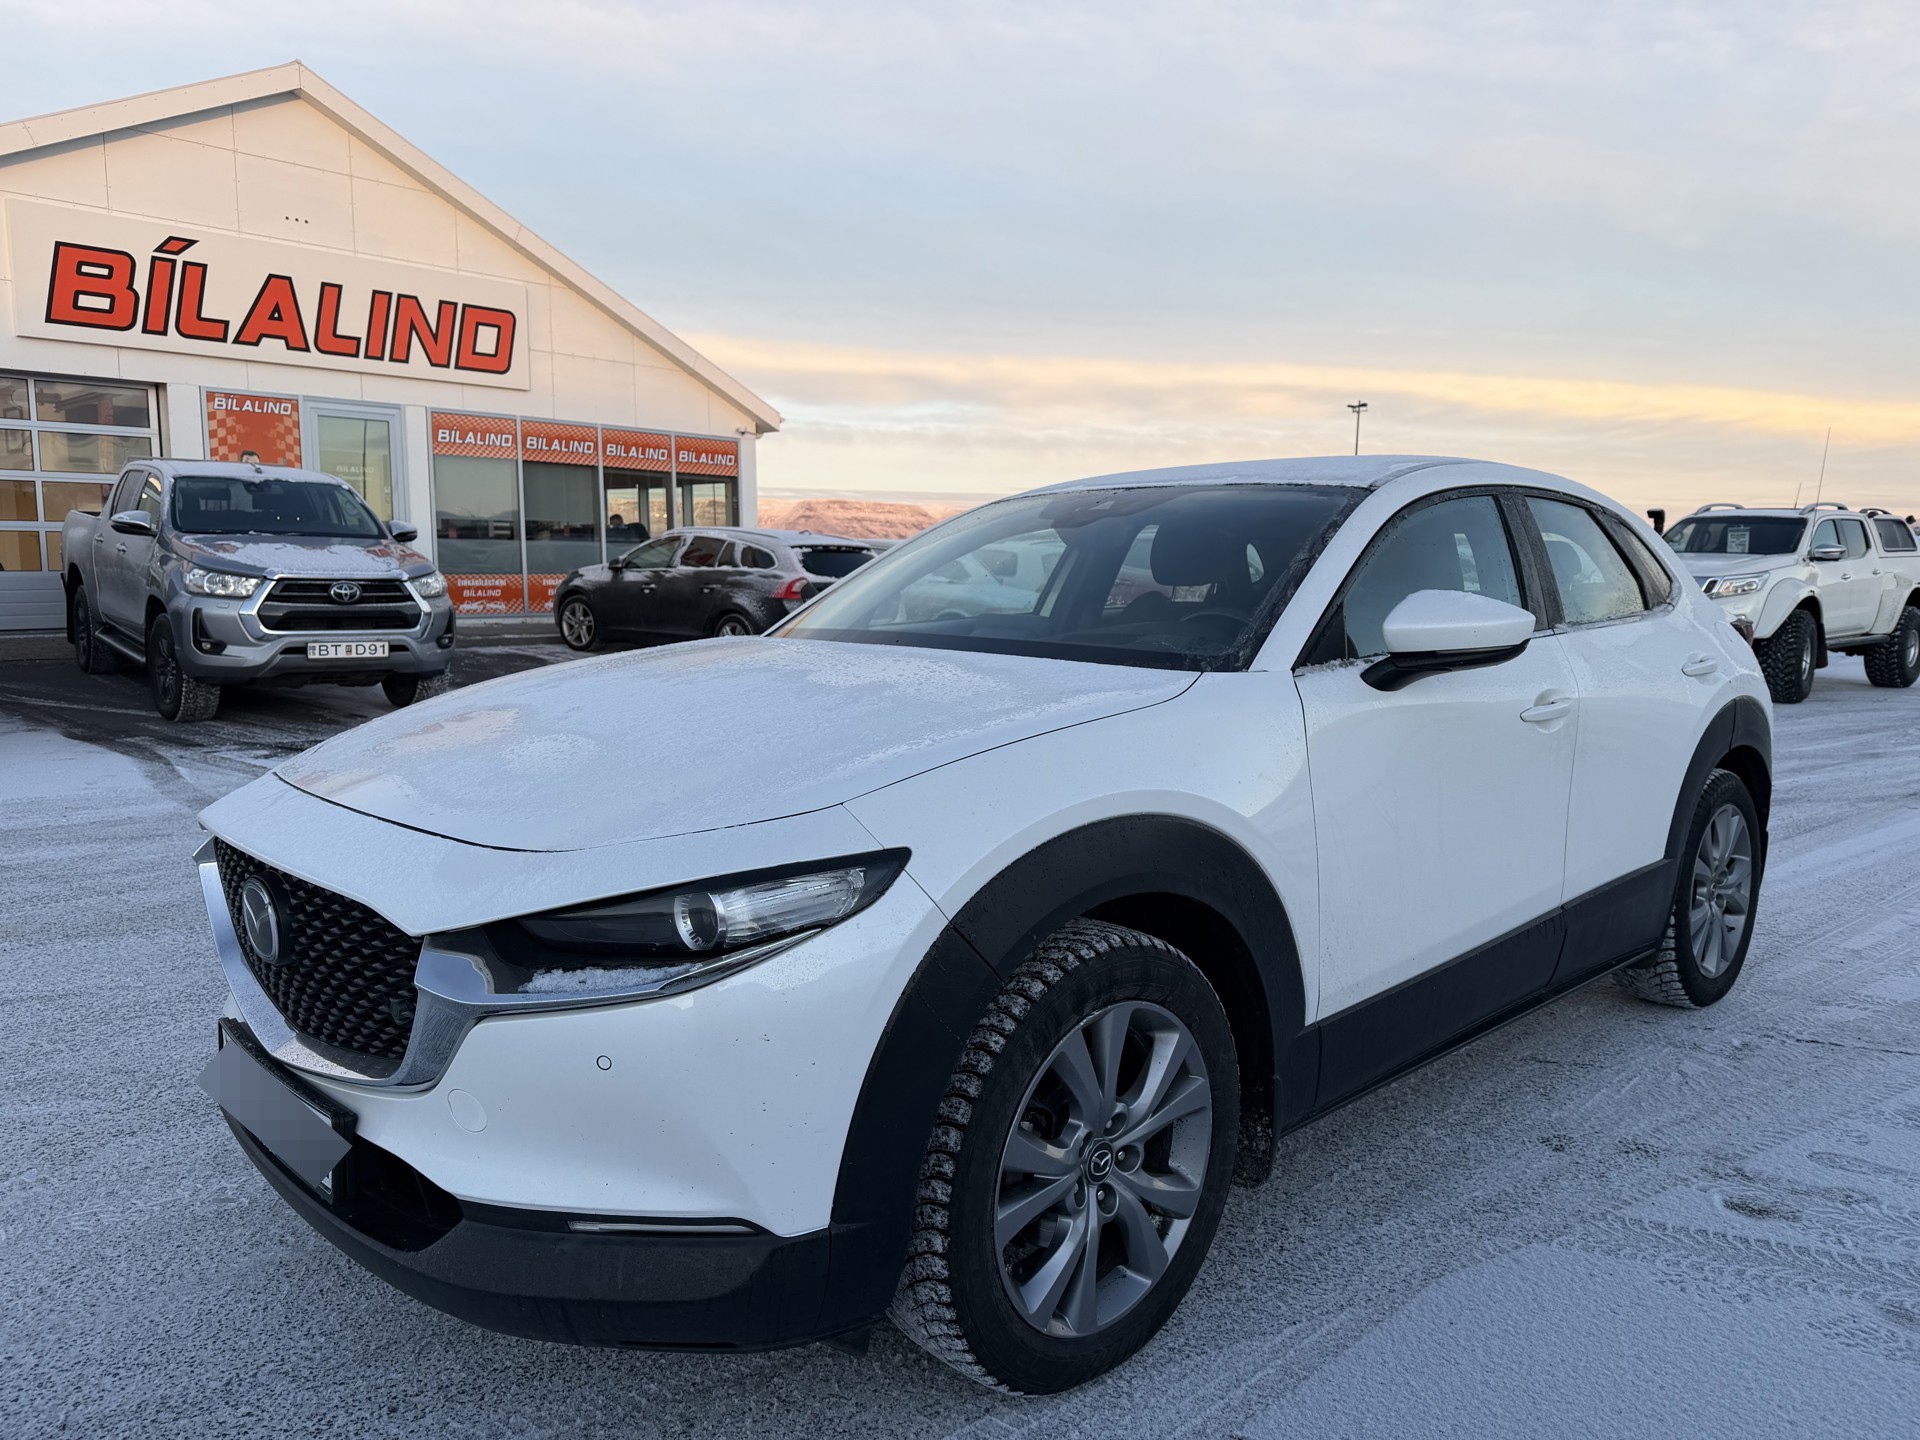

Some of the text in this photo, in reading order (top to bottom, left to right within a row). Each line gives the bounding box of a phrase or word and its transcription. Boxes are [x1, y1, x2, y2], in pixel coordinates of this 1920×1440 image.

[45, 235, 516, 375] BÍLALIND
[213, 394, 292, 415] BÍLALIND
[437, 426, 513, 447] BÍLALIND
[526, 433, 595, 454] BÍLALIND
[606, 441, 669, 461] BÍLALIND
[679, 448, 736, 466] BÍLALIND
[319, 643, 386, 656] BT D91
